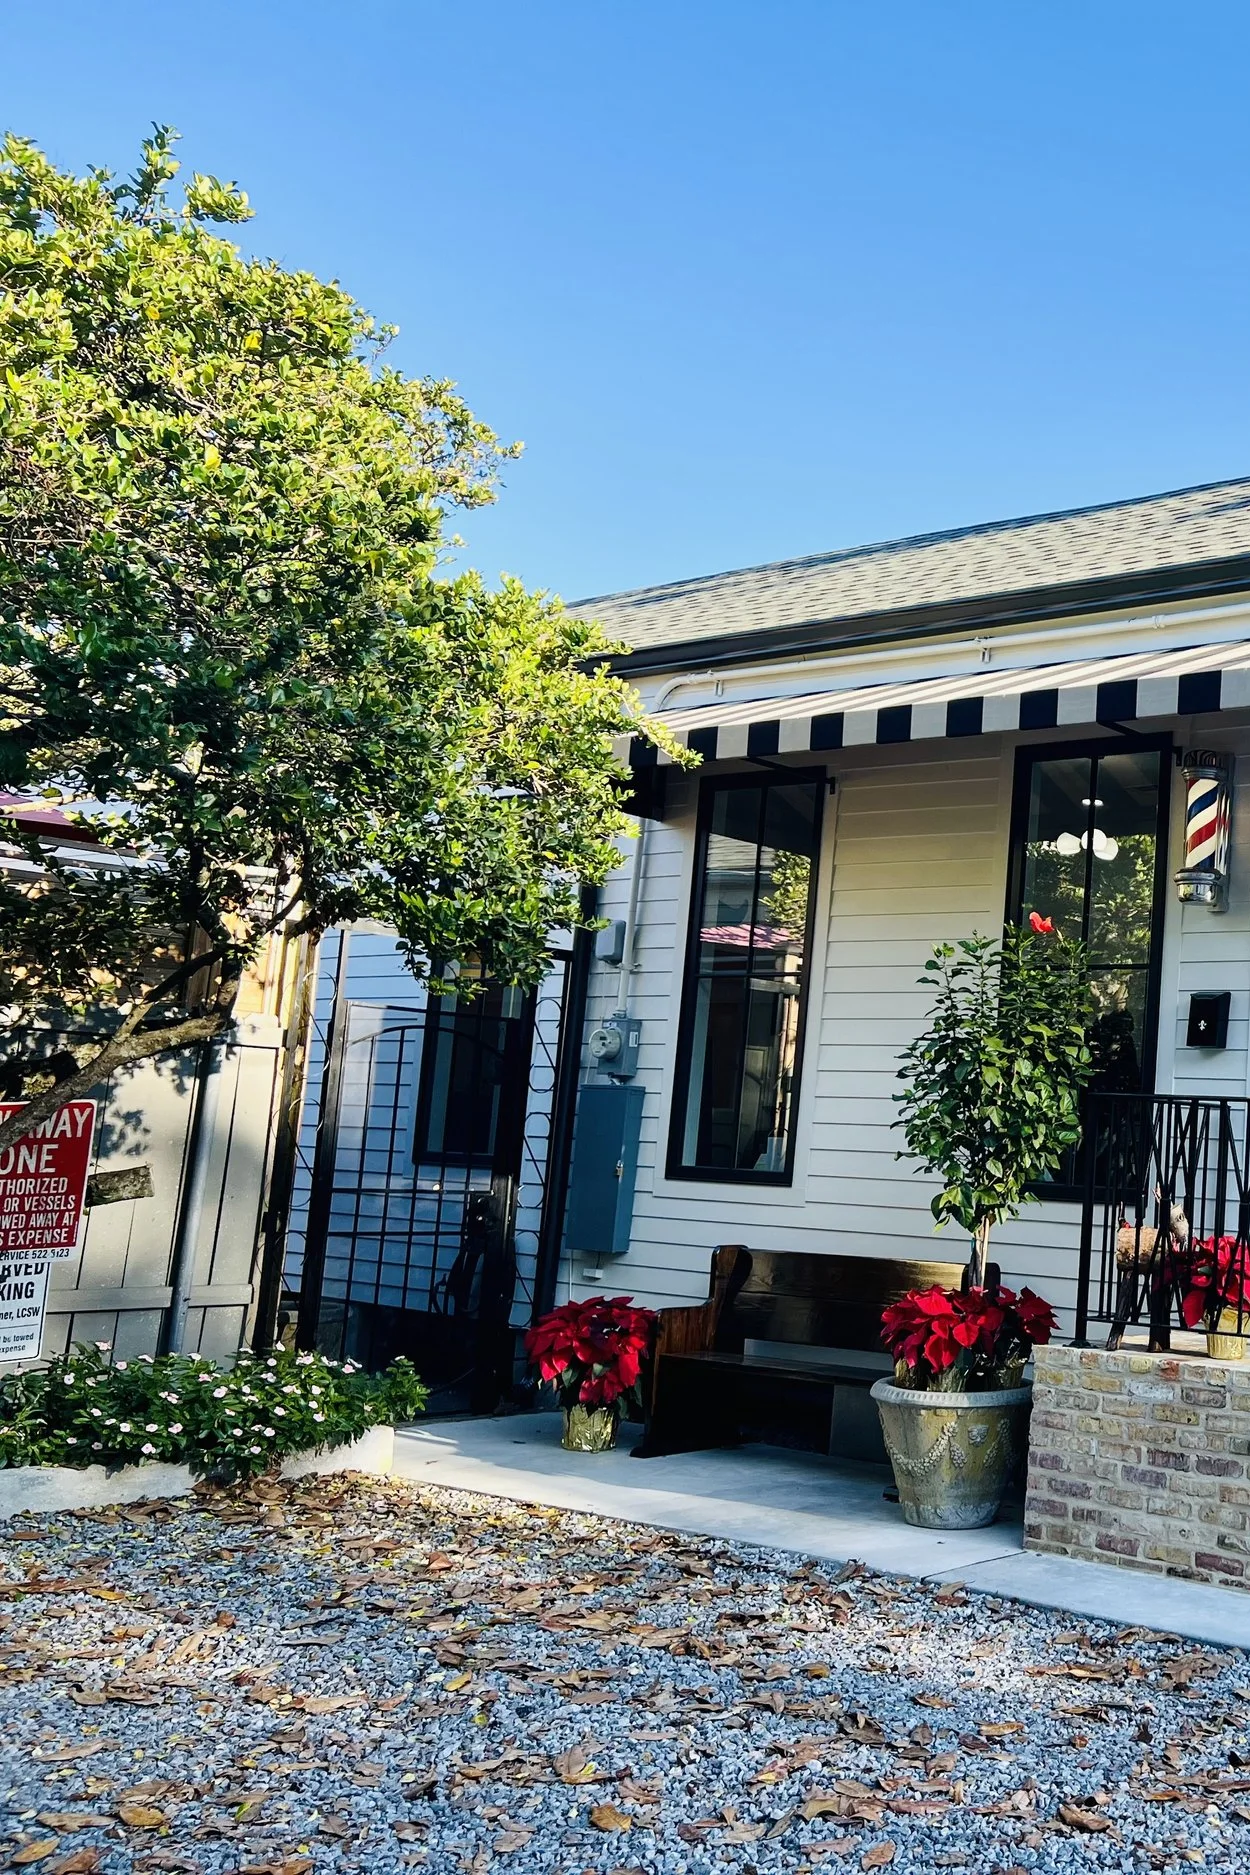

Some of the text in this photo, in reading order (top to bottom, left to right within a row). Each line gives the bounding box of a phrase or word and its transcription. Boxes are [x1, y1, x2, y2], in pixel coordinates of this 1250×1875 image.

[28, 1107, 93, 1138] WAY
[3, 1195, 76, 1212] OR VESSELS
[28, 1212, 59, 1228] AWAY
[61, 1211, 76, 1226] AT
[8, 1228, 69, 1246] EXPENSE
[31, 1250, 48, 1260] 522
[16, 1306, 41, 1319] LCSW
